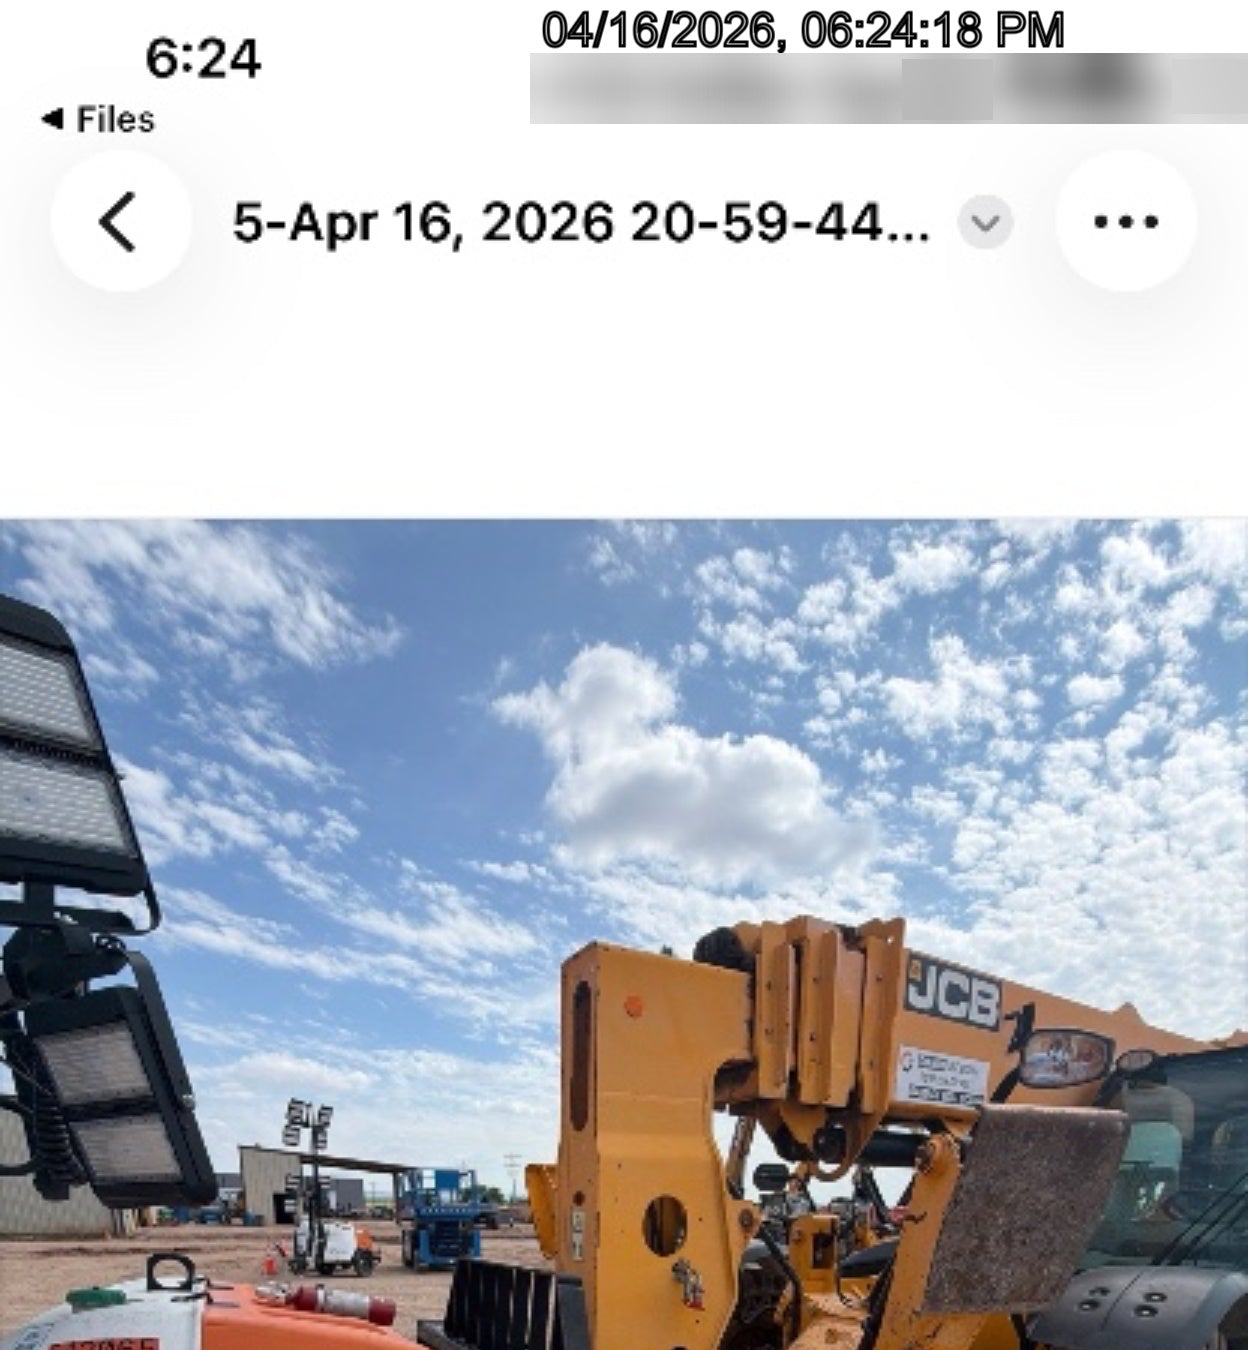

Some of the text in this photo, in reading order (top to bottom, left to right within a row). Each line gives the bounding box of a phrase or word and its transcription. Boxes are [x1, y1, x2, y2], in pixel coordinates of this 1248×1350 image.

[146, 36, 262, 79] 6:24
[78, 104, 155, 133] Files
[233, 202, 379, 252] 5-Apr
[394, 200, 463, 253] 16,
[482, 200, 614, 244] 2026
[908, 965, 1000, 1027] JCB
